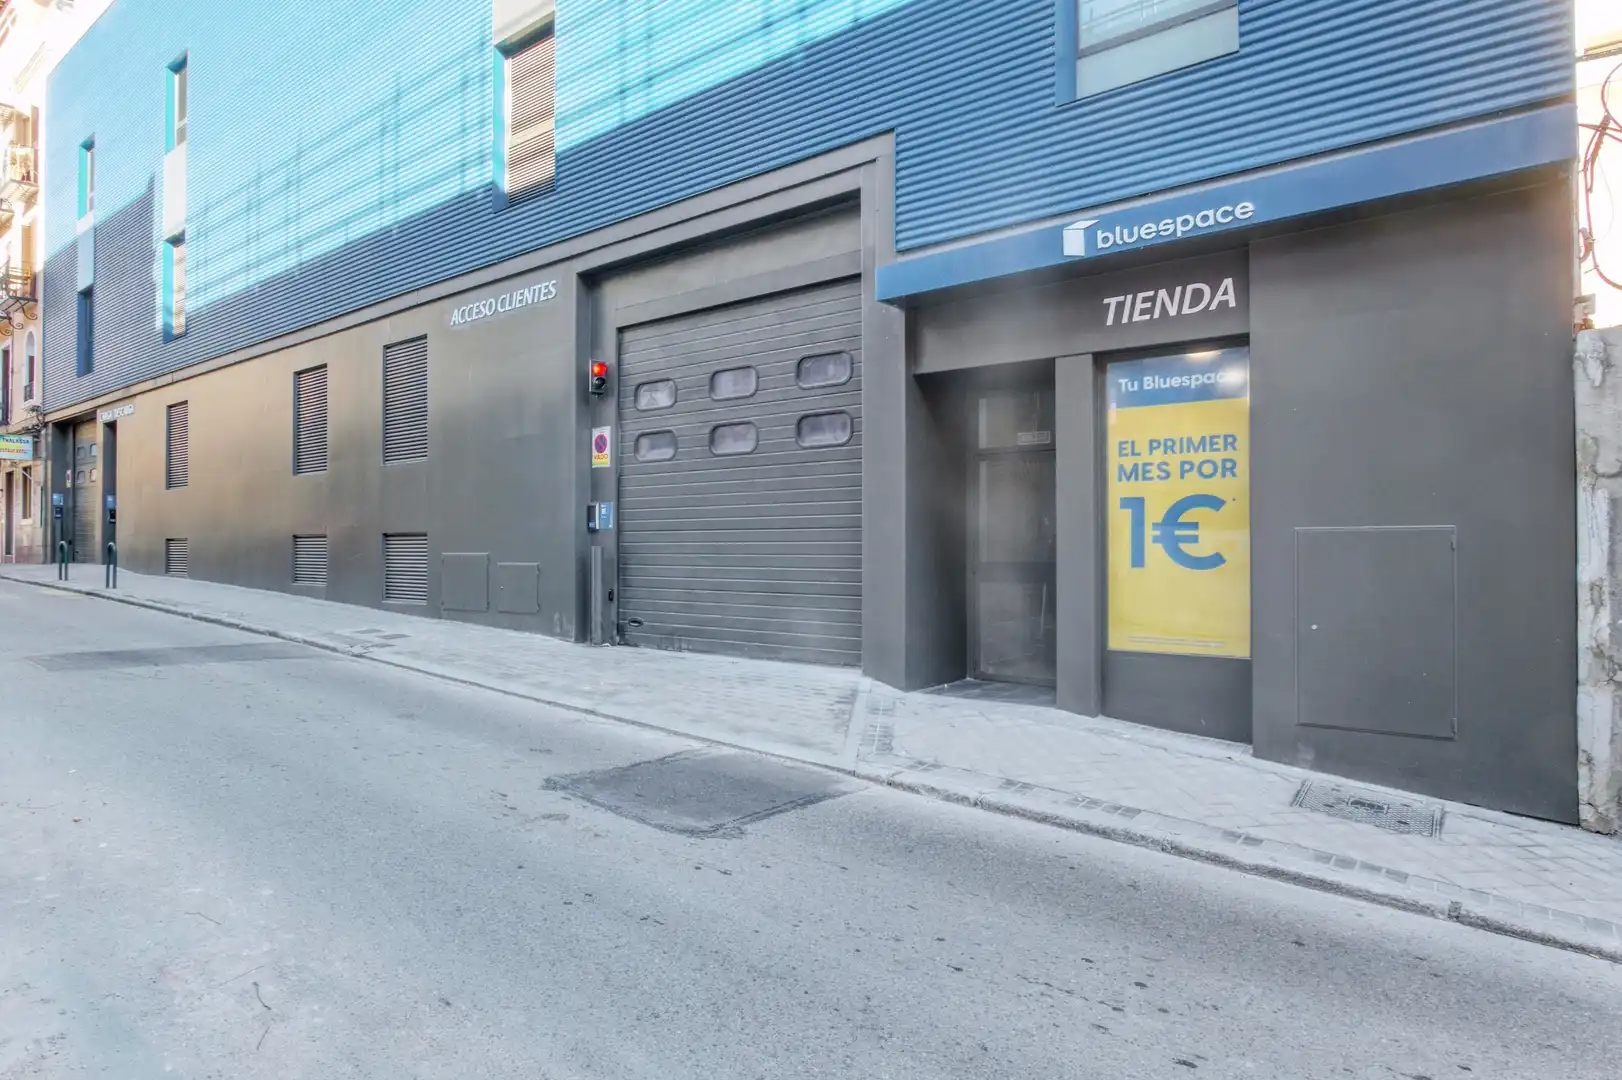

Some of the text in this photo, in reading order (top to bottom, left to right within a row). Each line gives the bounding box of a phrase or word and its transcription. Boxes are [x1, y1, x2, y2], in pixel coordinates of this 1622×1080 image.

[1096, 201, 1255, 249] bluespace
[450, 280, 557, 326] ACCESO CLIENTES
[1103, 277, 1236, 326] TIENDA
[1118, 371, 1245, 393] Tu Bluespac
[1118, 434, 1237, 458] EL PRIMER
[1117, 458, 1238, 483] MES POR
